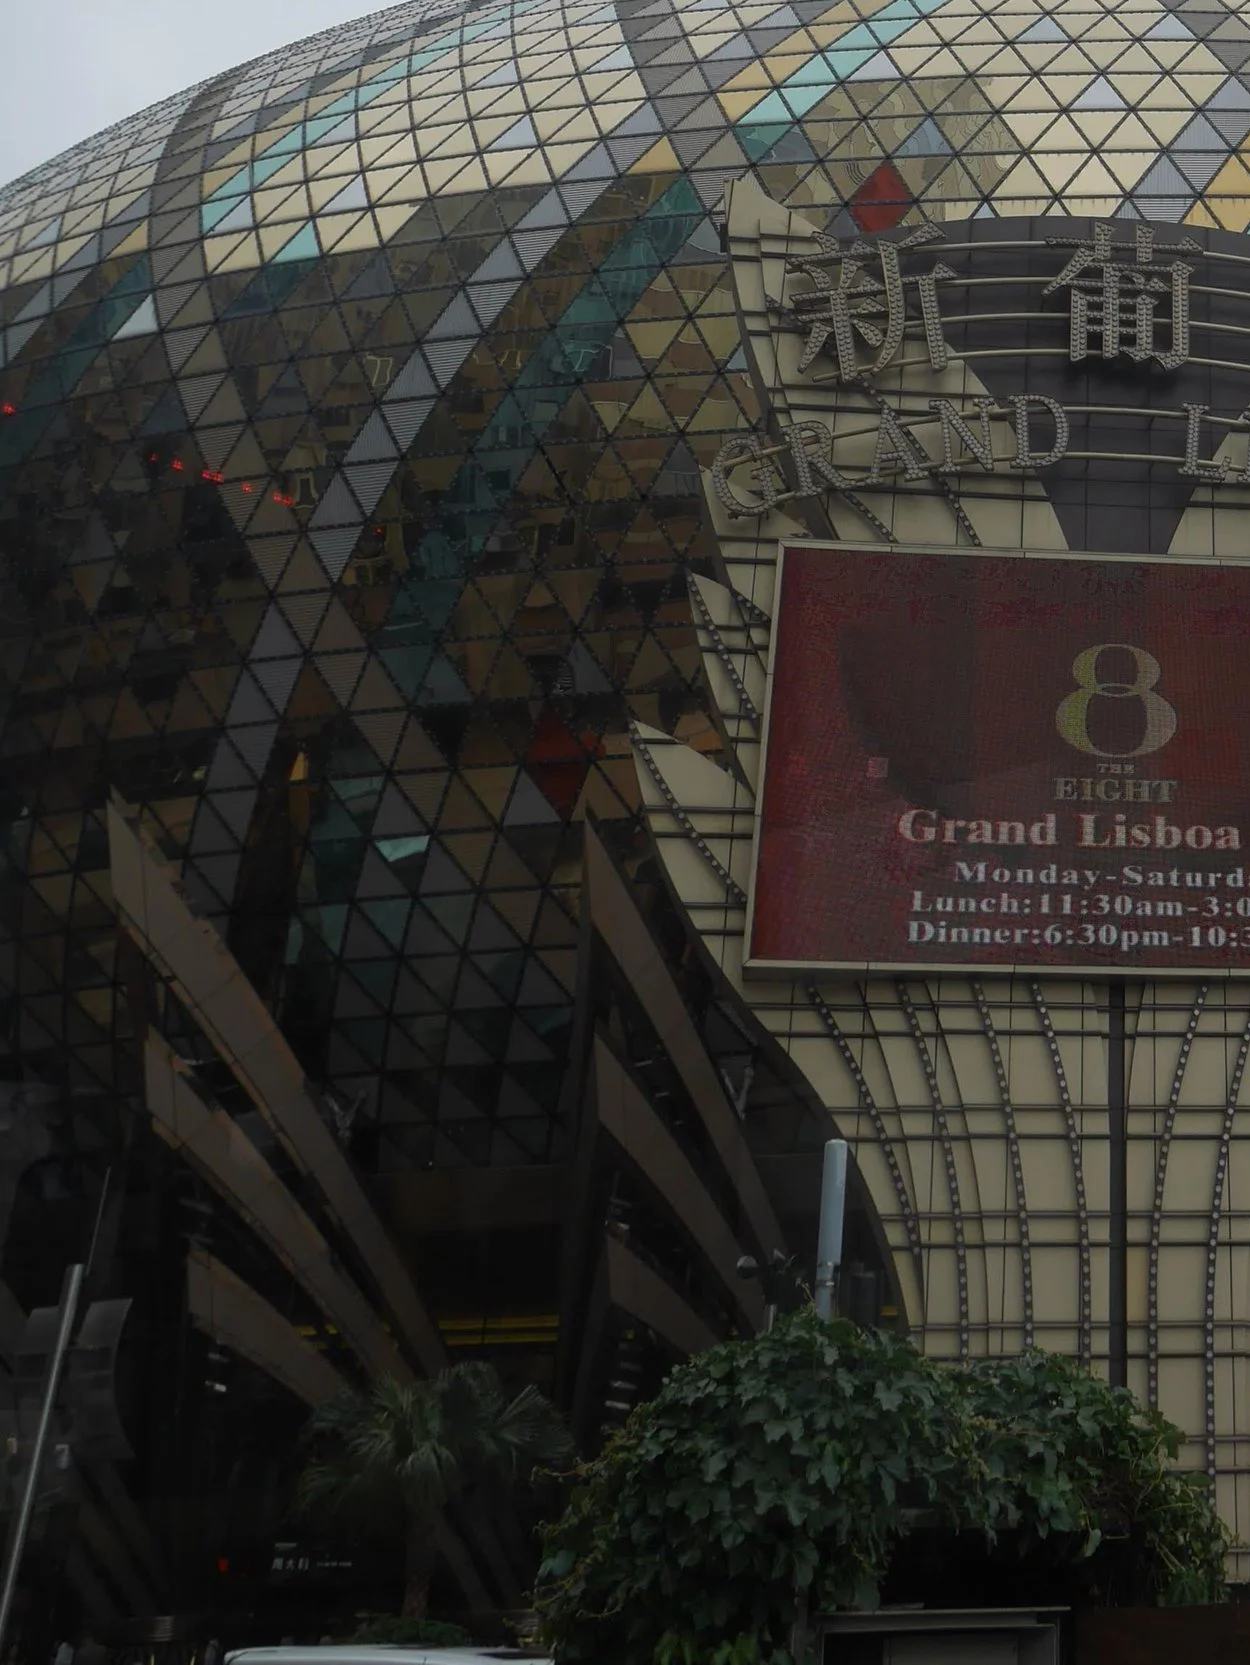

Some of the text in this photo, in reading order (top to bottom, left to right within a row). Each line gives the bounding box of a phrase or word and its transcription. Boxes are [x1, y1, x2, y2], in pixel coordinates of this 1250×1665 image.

[712, 393, 1070, 519] GRAND
[1055, 643, 1178, 758] 8
[1053, 777, 1179, 803] EIGHT
[1096, 762, 1136, 775] THE
[898, 808, 1059, 846] Grand
[1077, 812, 1241, 851] Lisboa
